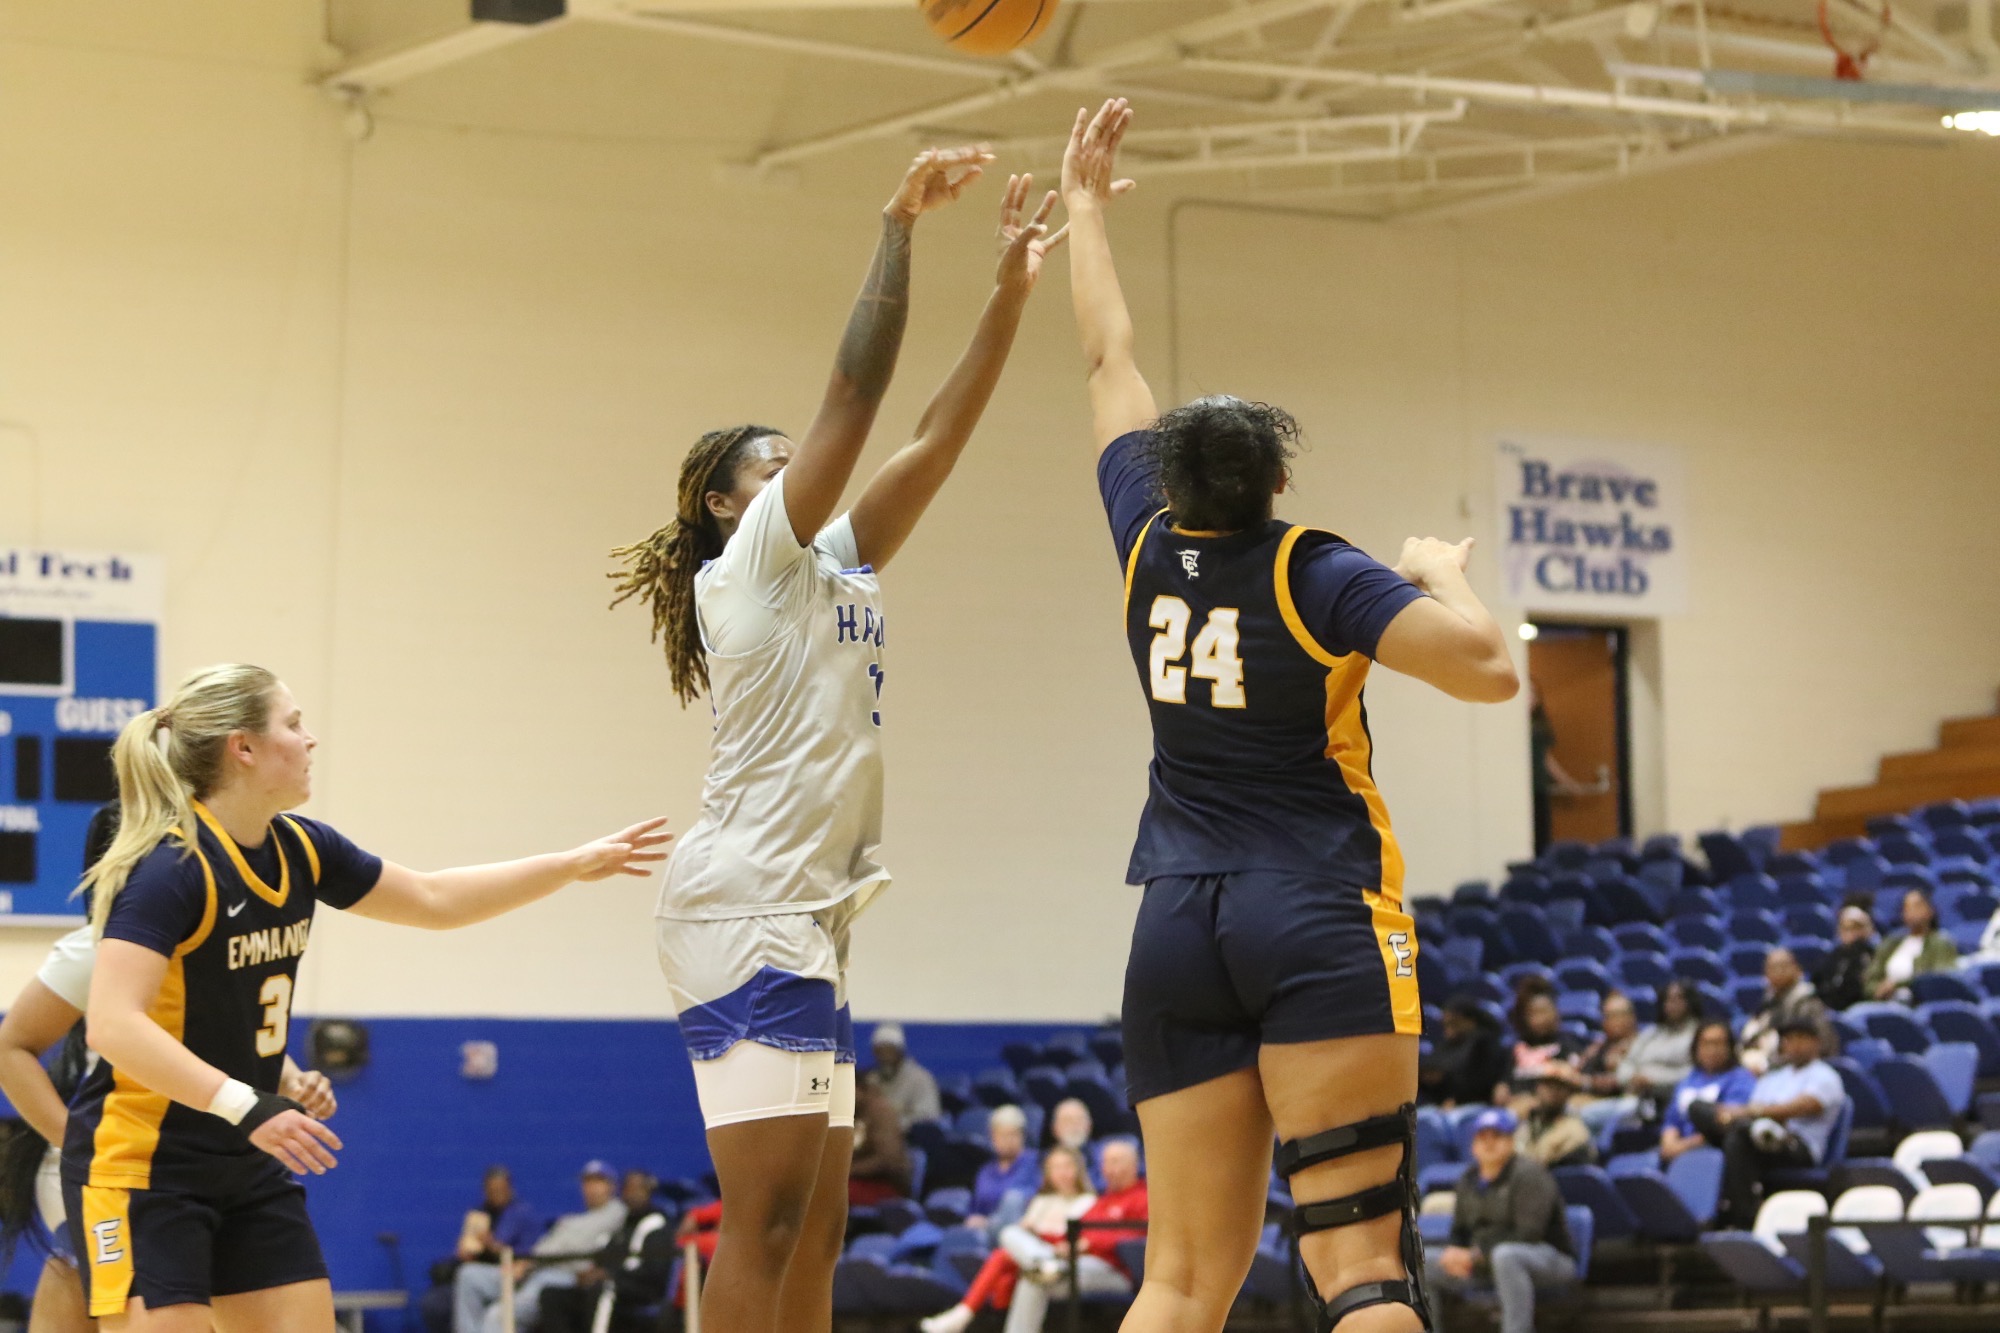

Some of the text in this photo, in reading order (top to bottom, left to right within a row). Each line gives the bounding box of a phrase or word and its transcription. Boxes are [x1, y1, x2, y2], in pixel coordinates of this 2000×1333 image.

[1521, 460, 1657, 508] Brave
[1509, 505, 1672, 553] Hawks
[34, 554, 132, 581] Tech
[1535, 553, 1649, 595] Club
[1149, 594, 1247, 709] 24
[1388, 932, 1412, 976] E
[255, 973, 293, 1058] 3
[93, 1218, 123, 1264] E
